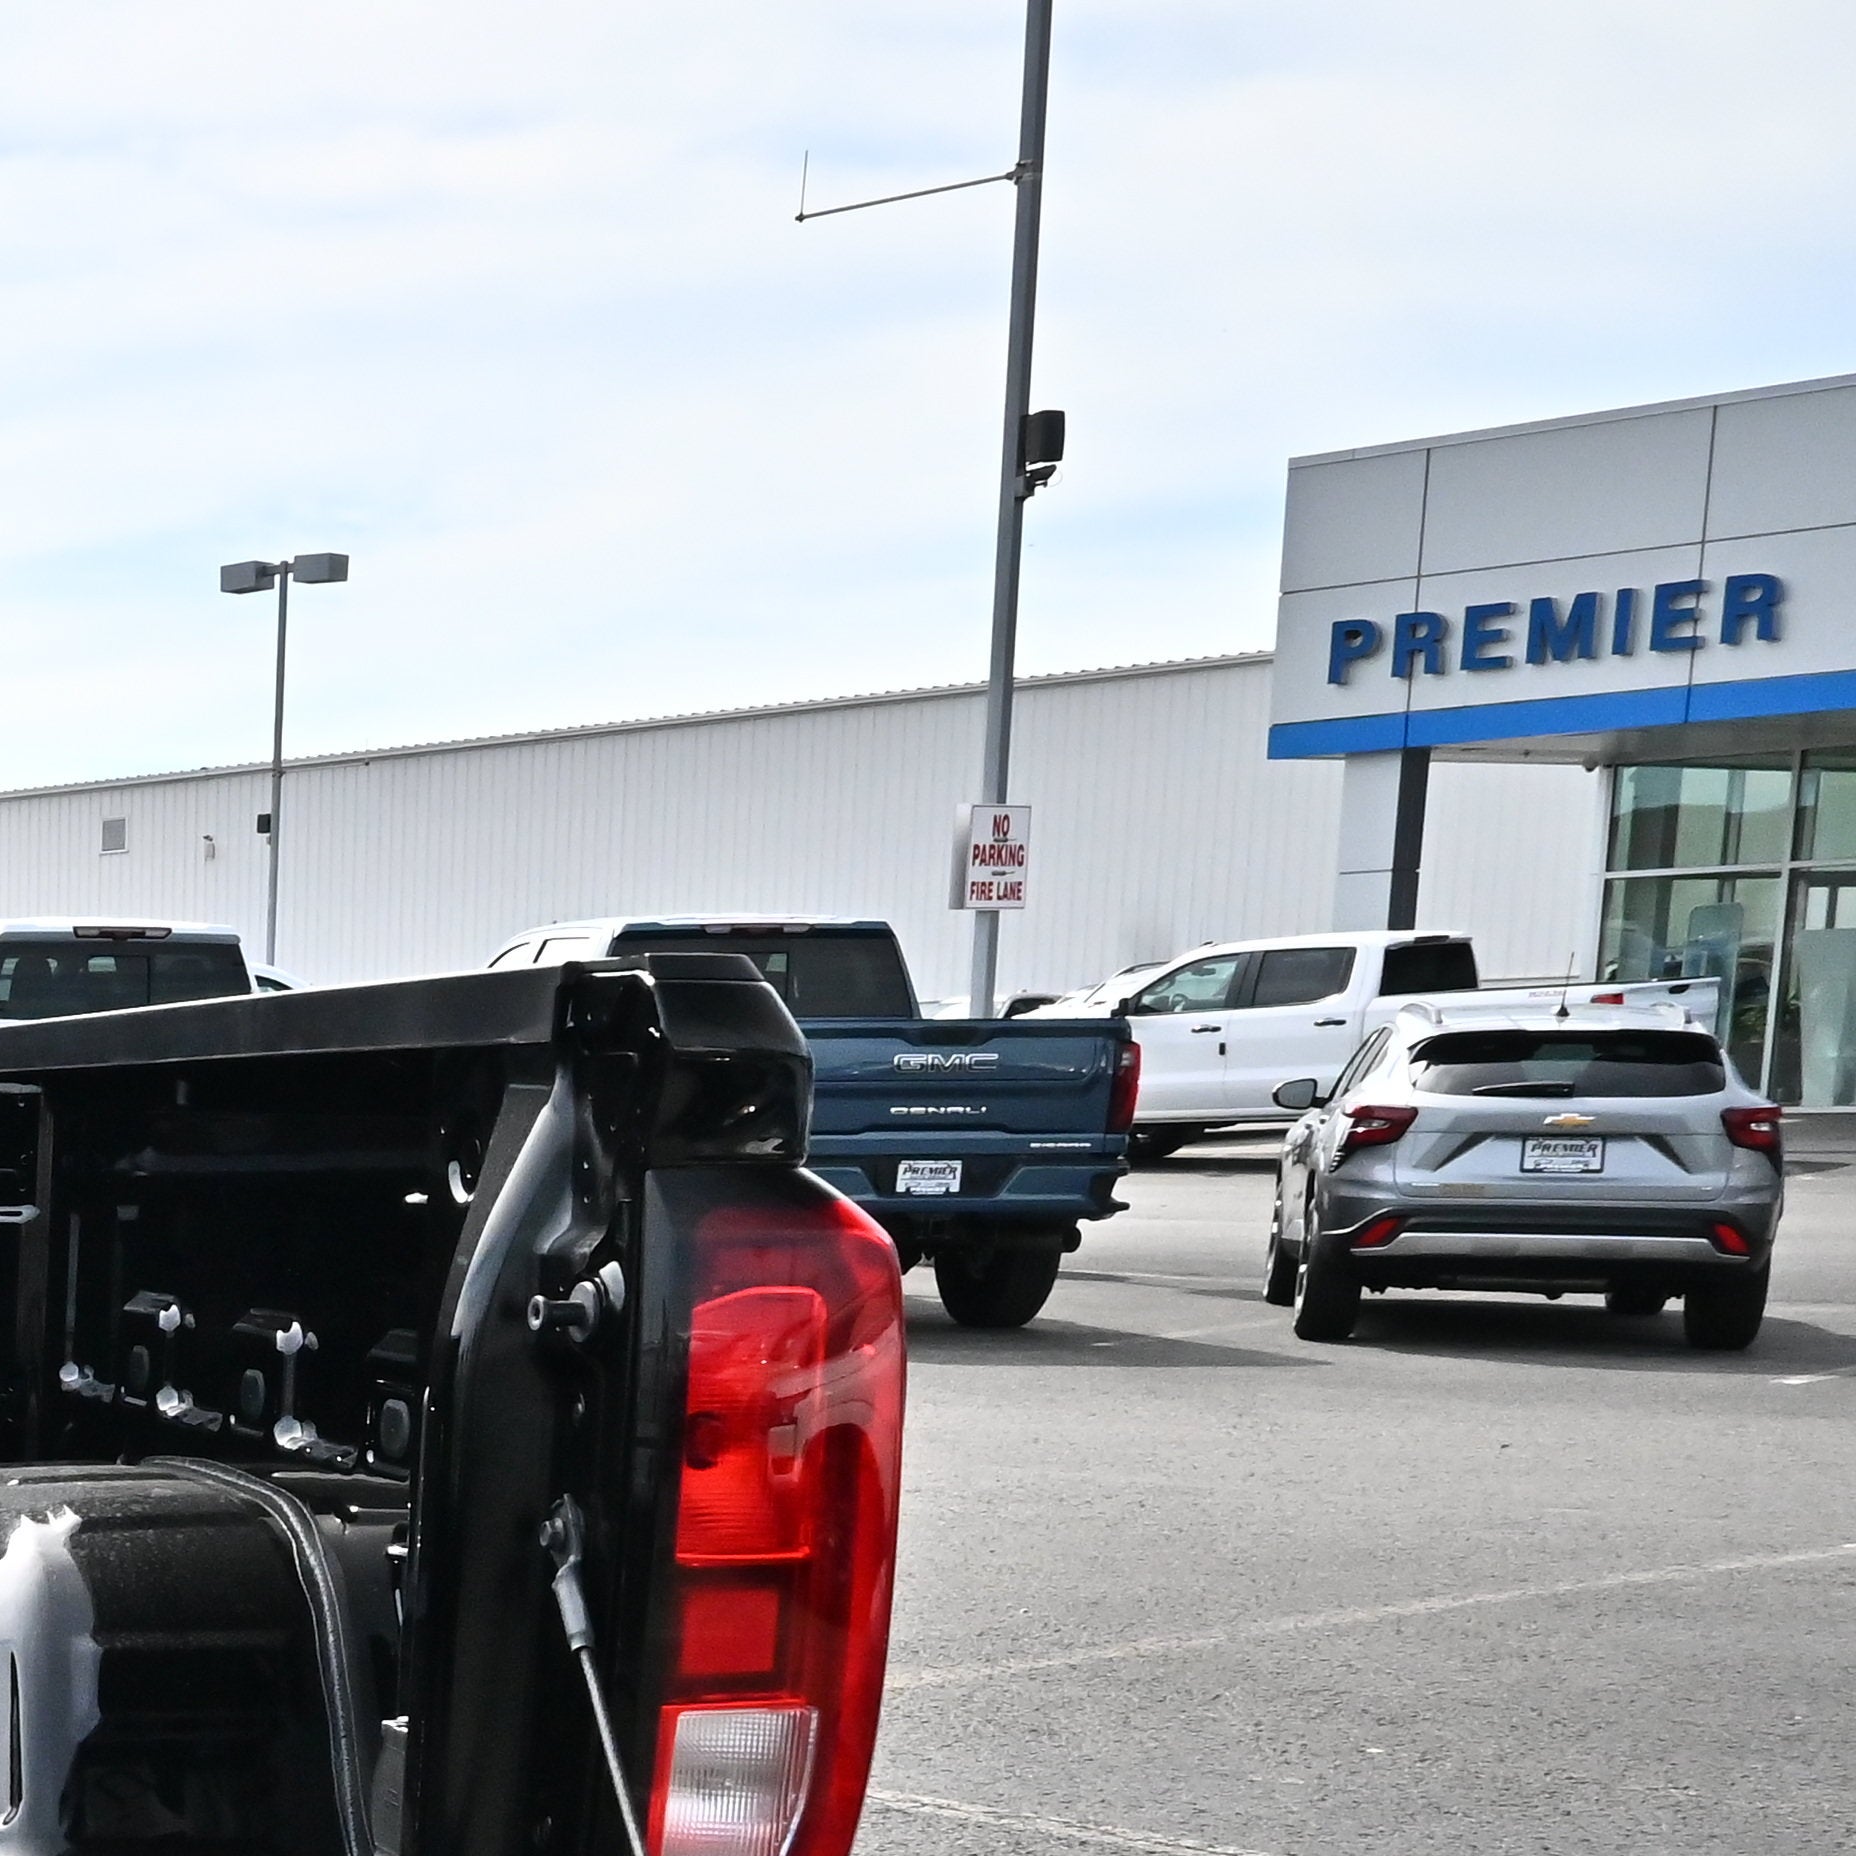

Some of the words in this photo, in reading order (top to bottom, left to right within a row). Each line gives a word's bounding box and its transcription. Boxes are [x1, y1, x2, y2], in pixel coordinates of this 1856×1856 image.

[1327, 572, 1790, 685] PREMIER
[992, 814, 1010, 838] NO
[972, 843, 1025, 867] PARKING
[969, 881, 994, 901] FIRE
[997, 881, 1023, 901] LANE
[893, 1053, 999, 1073] GMC
[890, 1106, 987, 1115] DENALI
